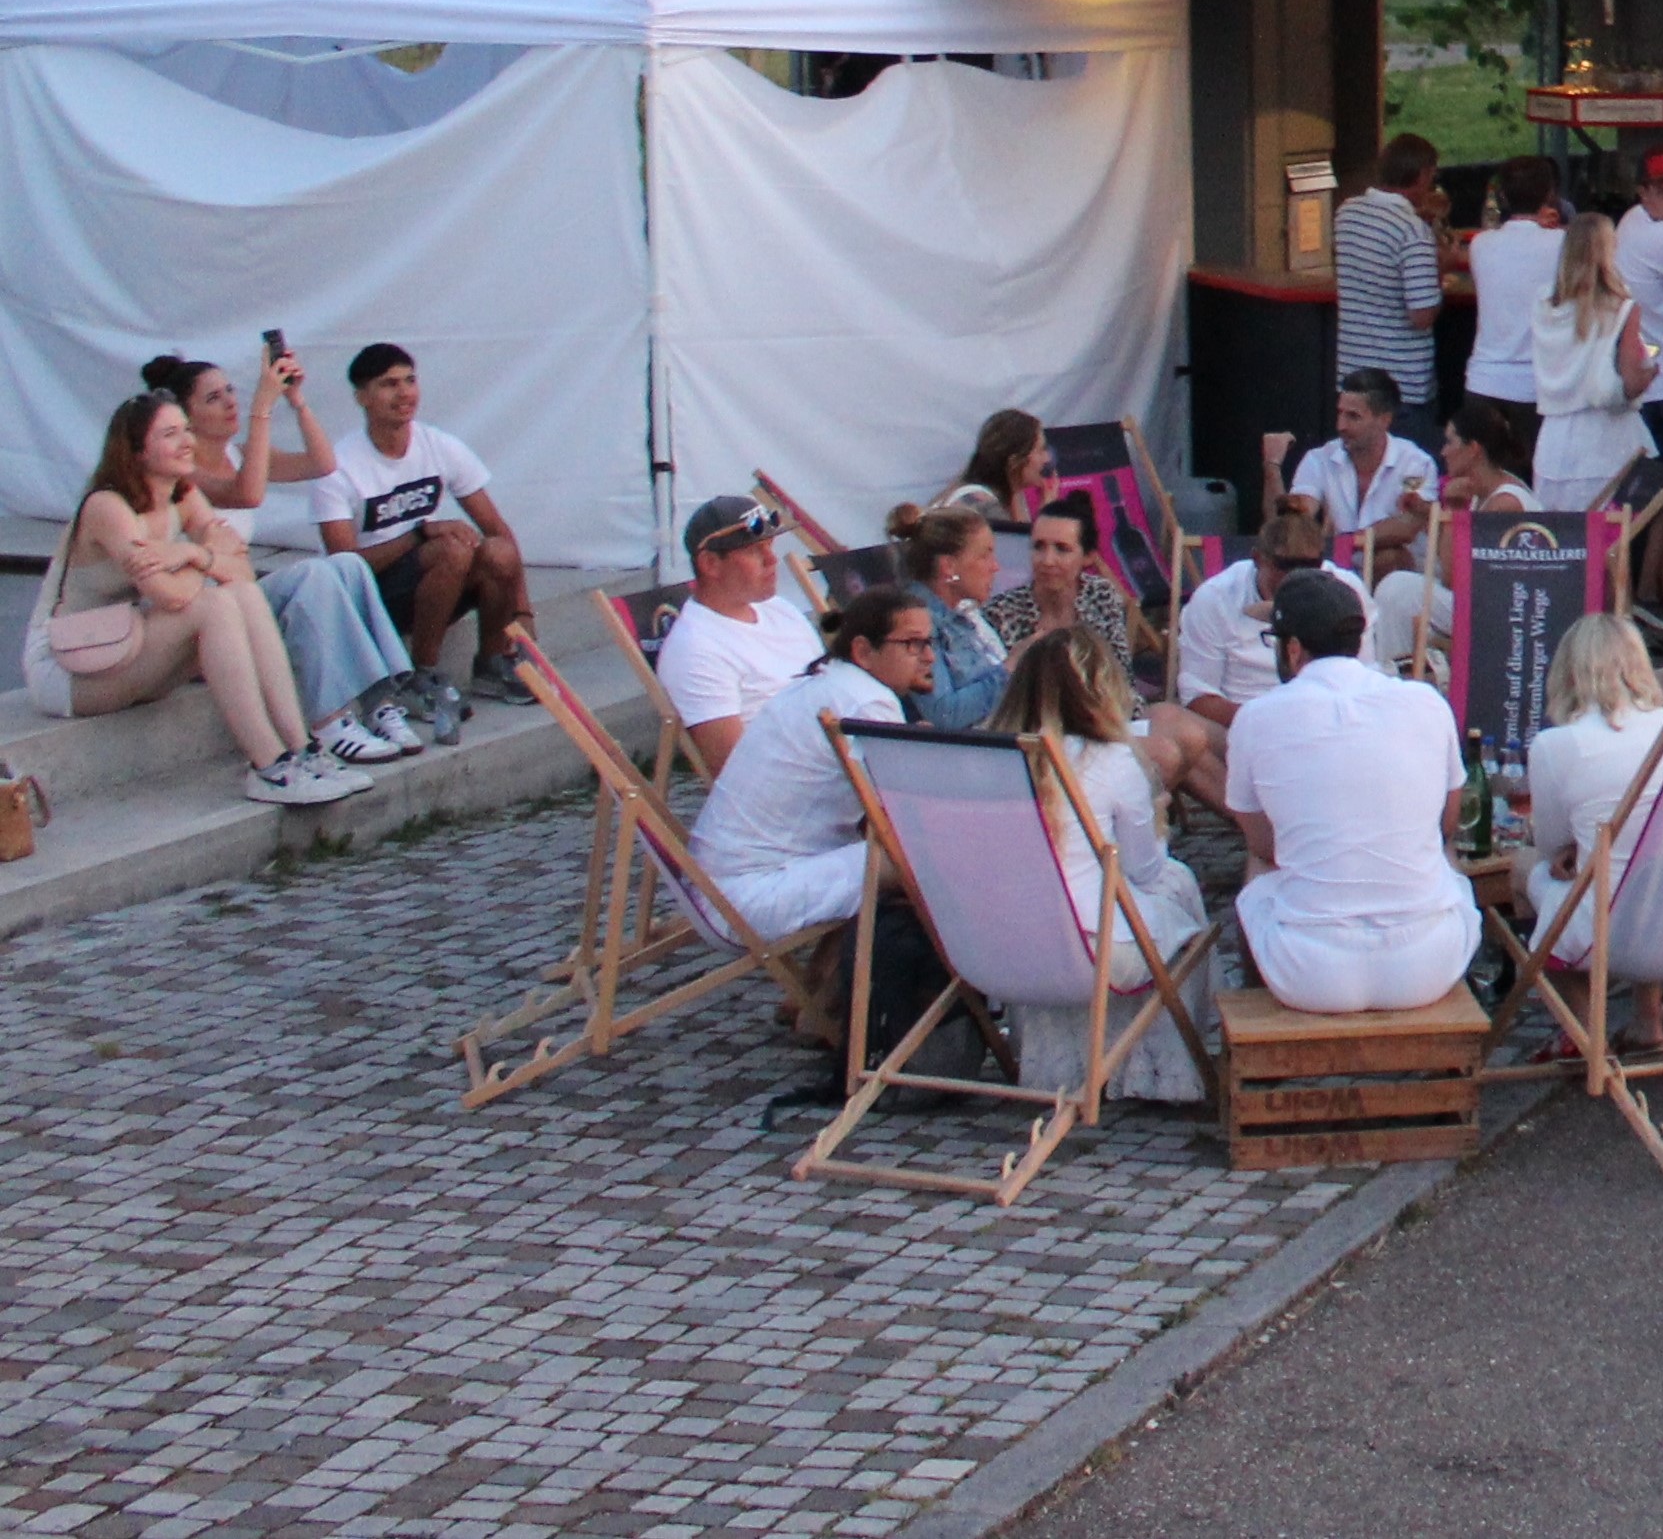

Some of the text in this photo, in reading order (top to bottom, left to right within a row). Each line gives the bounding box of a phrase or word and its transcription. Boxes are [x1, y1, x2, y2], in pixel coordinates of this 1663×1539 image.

[1471, 548, 1588, 561] REMSTALKELLEREI
[1508, 581, 1529, 623] Liege
[1529, 587, 1551, 637] Wiege
[1506, 625, 1524, 672] dieser
[1505, 672, 1522, 698] auf
[1264, 1088, 1366, 1120] Wein
